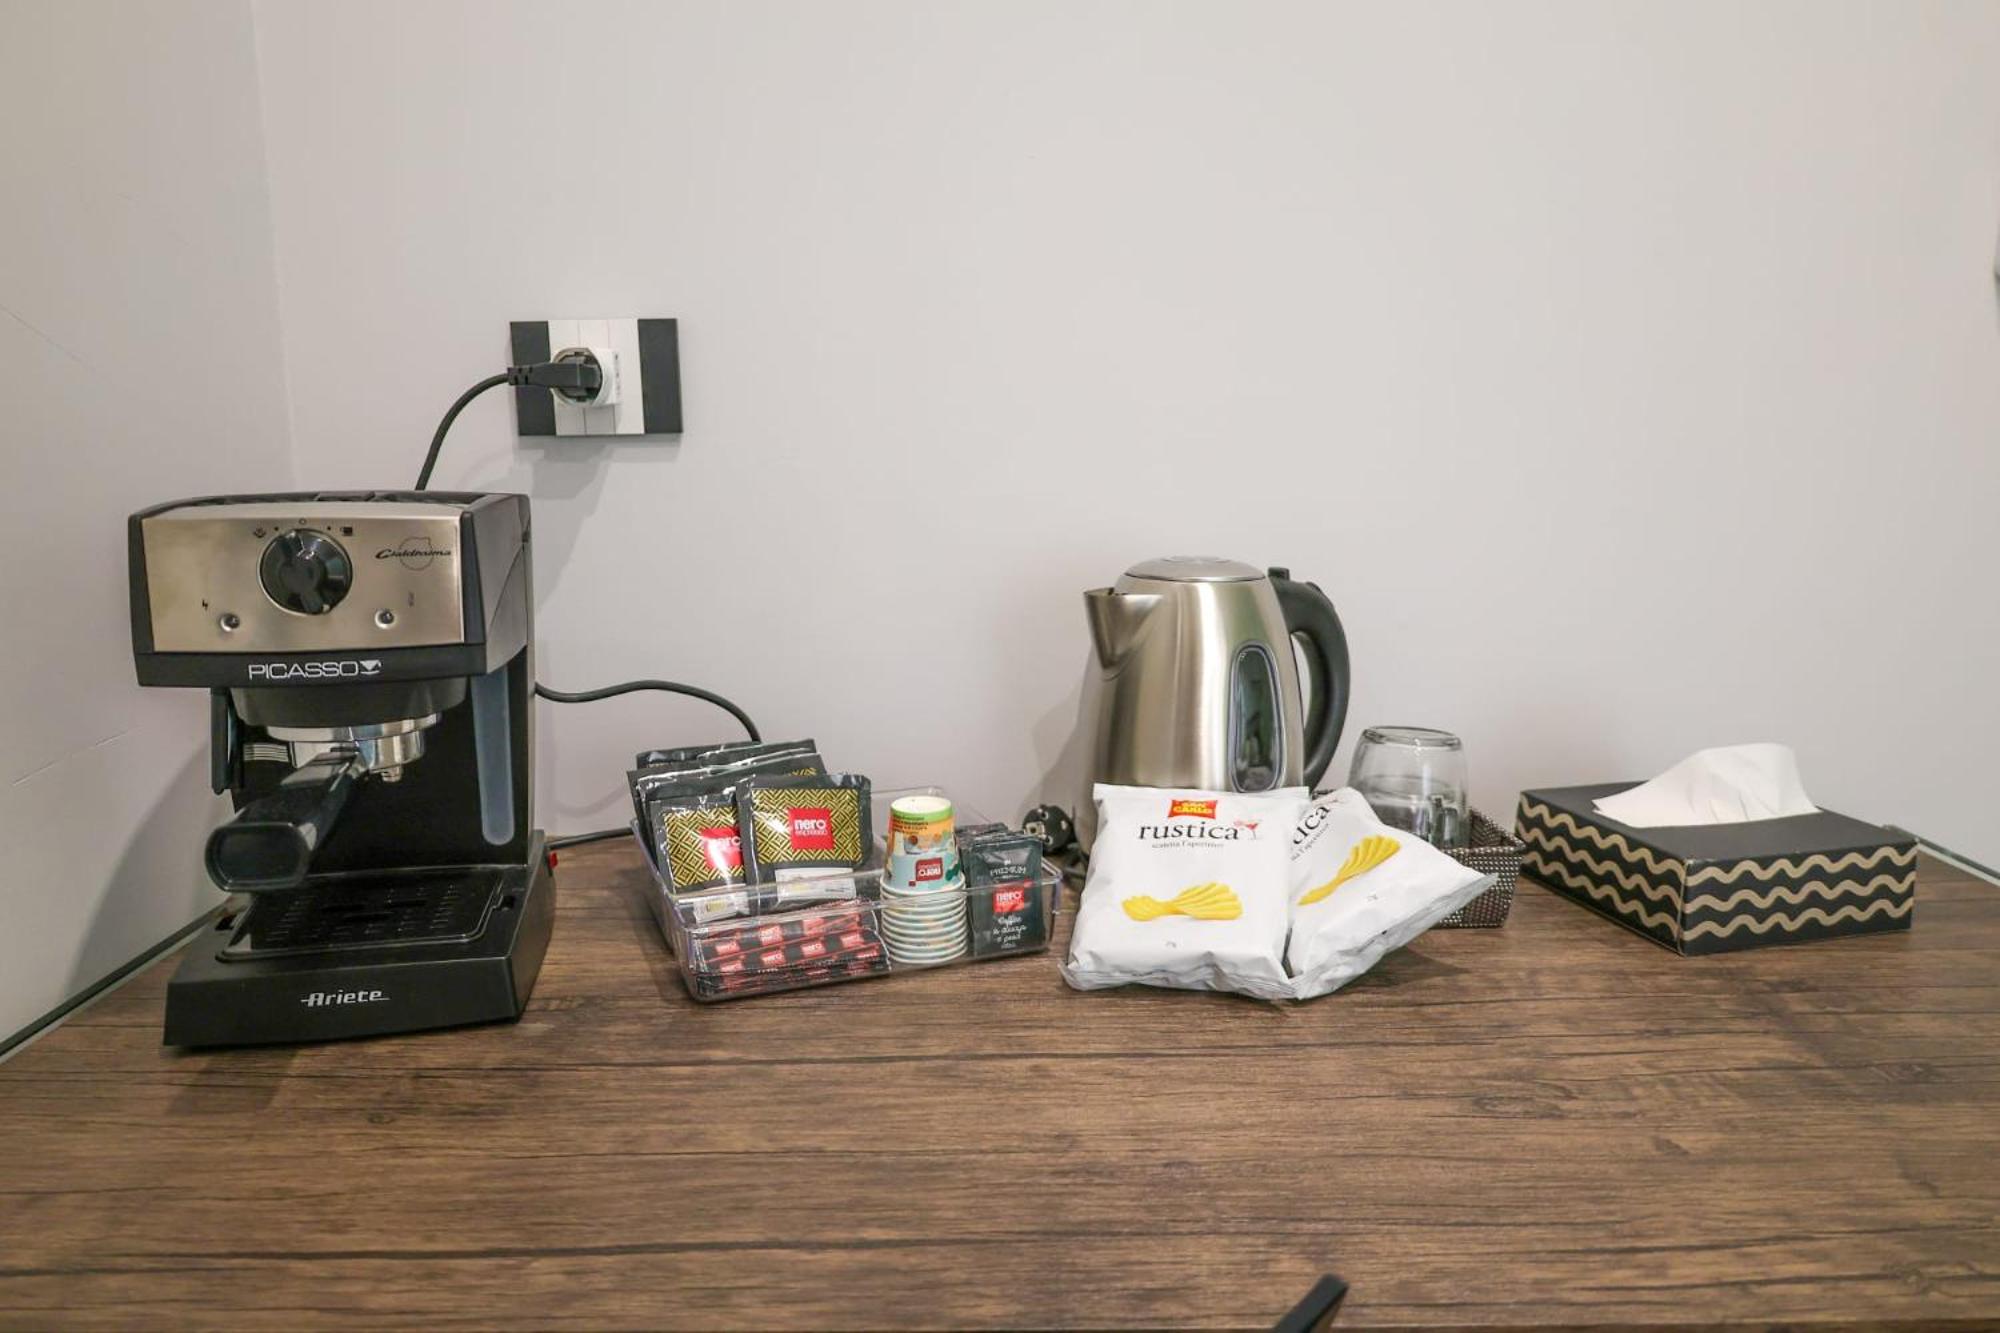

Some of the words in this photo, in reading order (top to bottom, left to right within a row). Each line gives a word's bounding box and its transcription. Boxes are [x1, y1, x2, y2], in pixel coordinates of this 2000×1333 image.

[248, 660, 359, 680] PICASSO
[794, 819, 826, 831] nero
[1138, 821, 1239, 840] rustica
[995, 890, 1021, 903] nero
[301, 989, 390, 1007] Ariete
